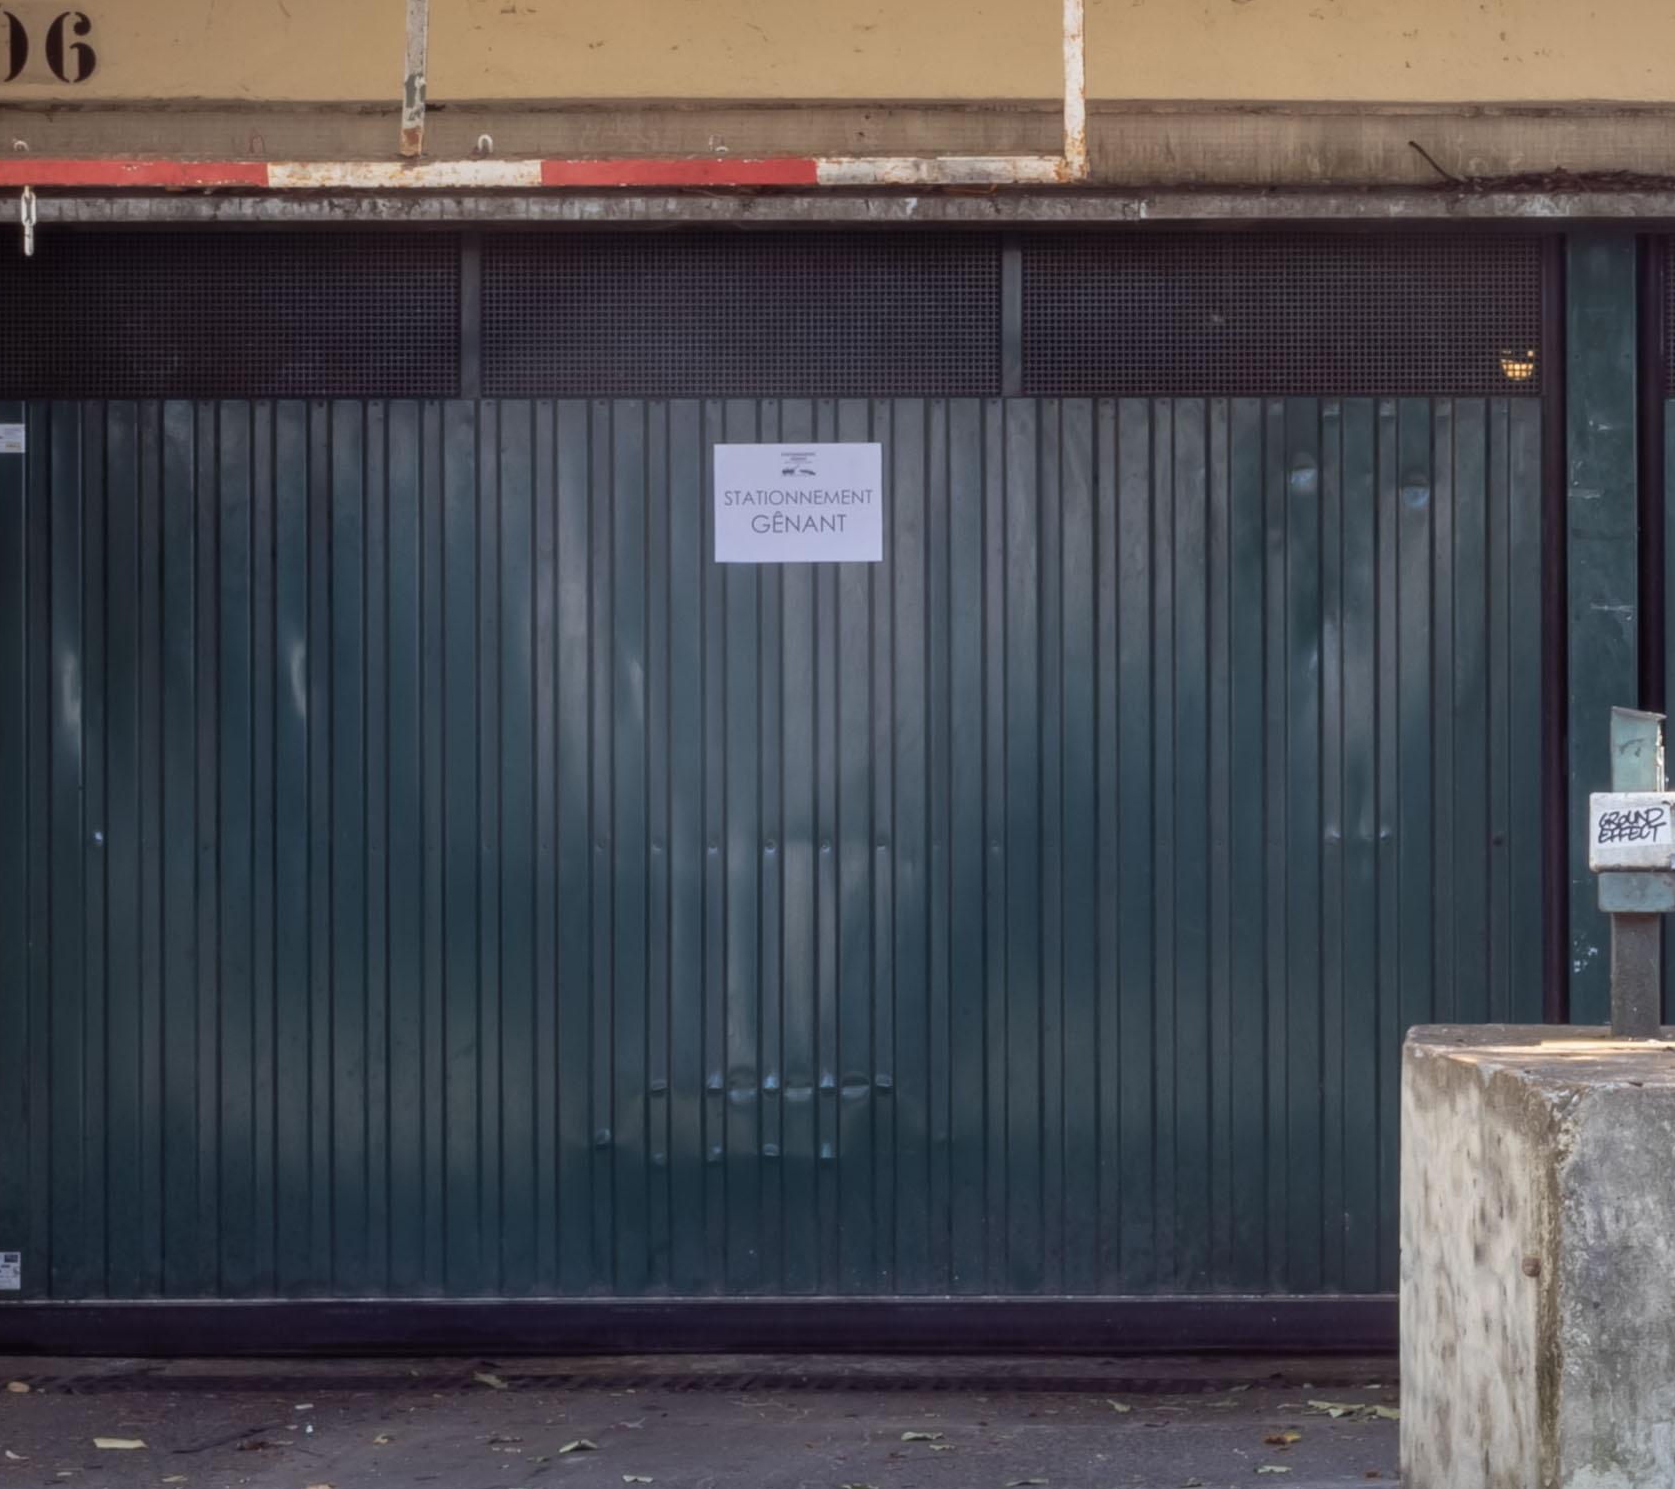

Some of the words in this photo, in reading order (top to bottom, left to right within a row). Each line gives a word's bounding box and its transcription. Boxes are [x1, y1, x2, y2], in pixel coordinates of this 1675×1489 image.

[724, 489, 873, 506] STATIONNEMENT
[751, 511, 847, 534] GÊNANT
[1599, 807, 1666, 828] GROUND
[1598, 821, 1666, 844] EFFECT
